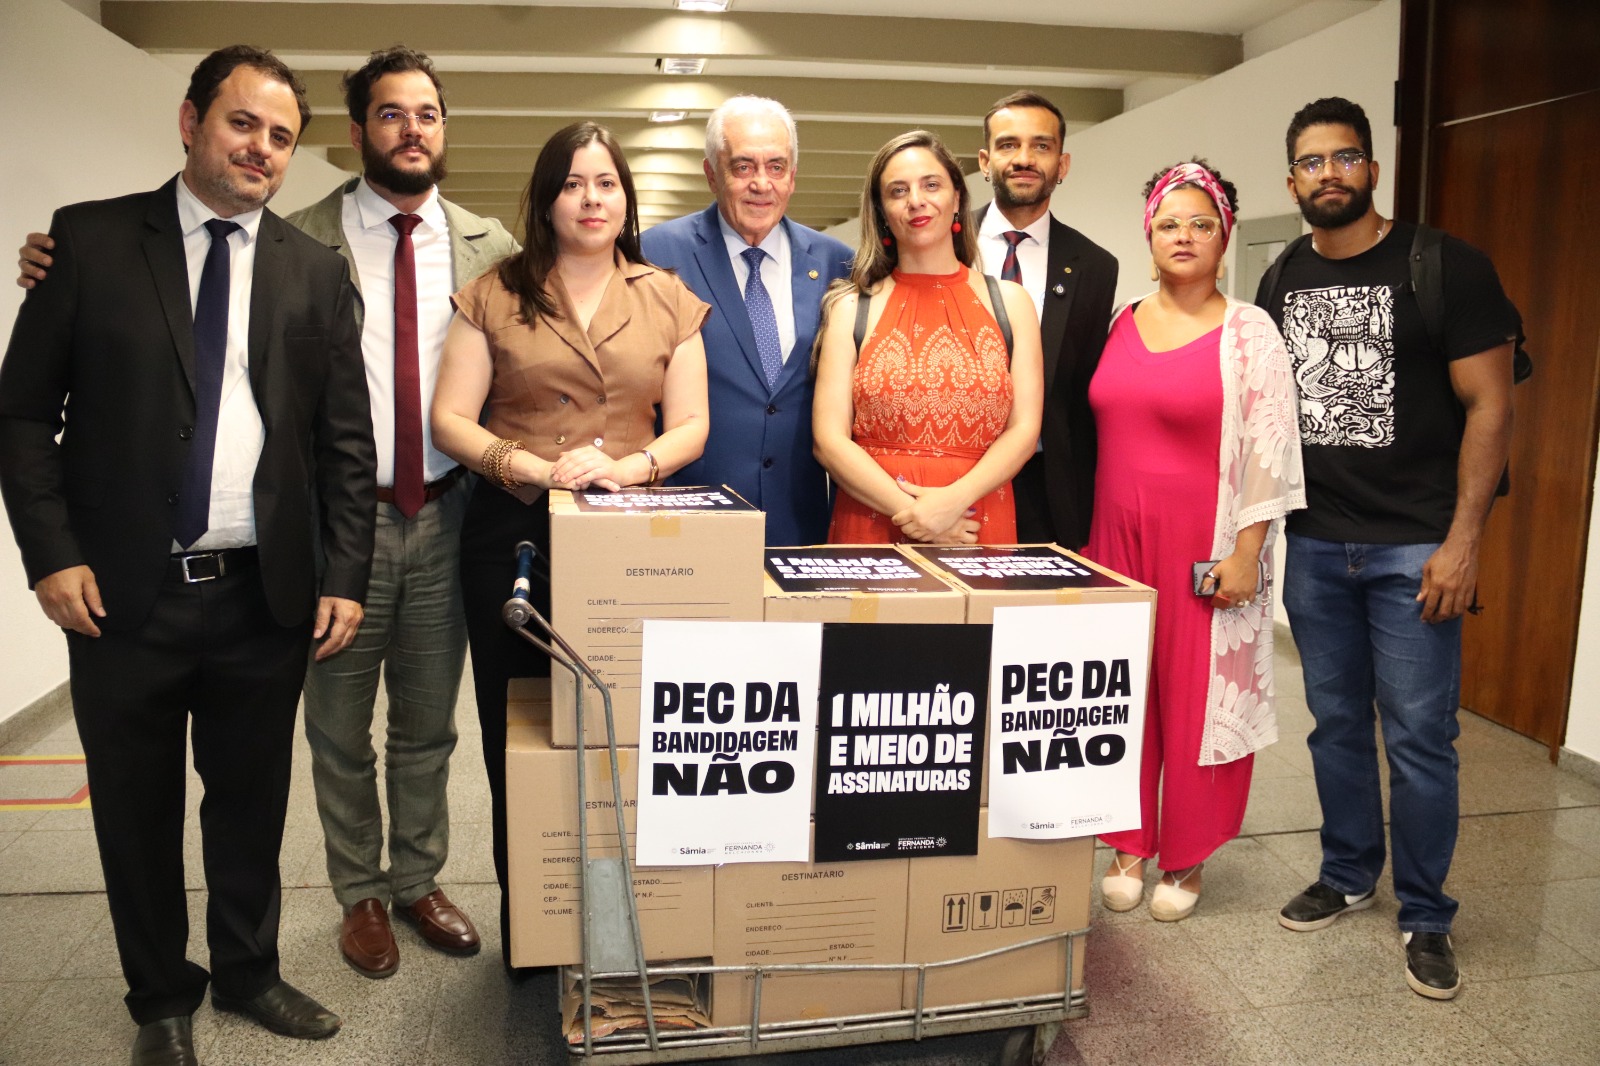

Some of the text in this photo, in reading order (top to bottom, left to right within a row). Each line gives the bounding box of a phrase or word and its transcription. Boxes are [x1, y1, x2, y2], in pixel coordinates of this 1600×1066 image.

[786, 556, 904, 567] MILHÃO
[944, 560, 1078, 570] E MEIO DE
[625, 566, 695, 577] DESTINATÁRIO
[775, 564, 915, 575] E MEIO DE
[957, 568, 1077, 579] MILHÃO
[587, 626, 629, 635] ENDEREÇO:
[587, 654, 617, 662] CIDADE:
[591, 668, 605, 676] EP.:
[1001, 658, 1132, 705] PEC DA
[652, 681, 801, 724] PEC DA
[831, 682, 975, 728] 1 MILHÃO
[1001, 704, 1129, 733] BANDIDAGEM
[652, 729, 798, 754] BANDIDAGEM
[829, 732, 973, 767] E MEIO DE
[1002, 727, 1126, 775] NÃO
[652, 752, 796, 797] NÃO
[827, 769, 971, 795] ASSINATURAS
[1029, 821, 1055, 830] Sâmia
[1070, 816, 1103, 825] FERNANDA
[724, 844, 763, 852] FERNANDA
[855, 841, 881, 851] Sâmia
[898, 839, 935, 848] FERNANDA
[680, 846, 707, 855] Sâmia
[781, 870, 845, 881] DESTINATÁRIO
